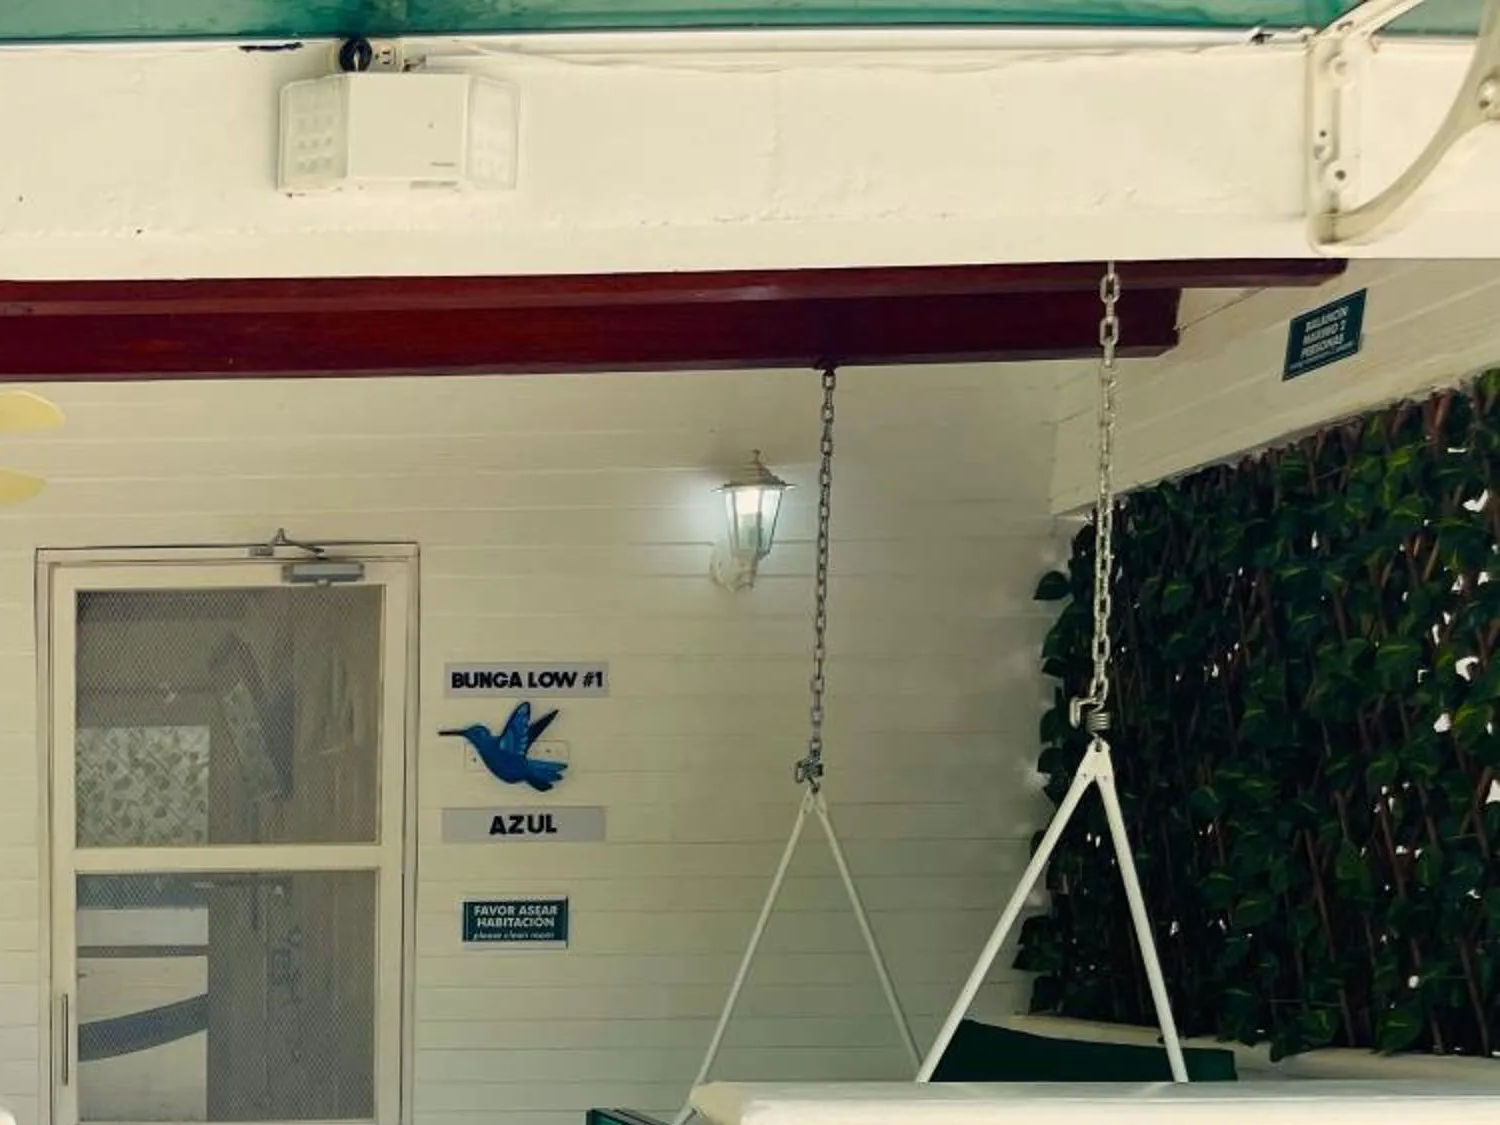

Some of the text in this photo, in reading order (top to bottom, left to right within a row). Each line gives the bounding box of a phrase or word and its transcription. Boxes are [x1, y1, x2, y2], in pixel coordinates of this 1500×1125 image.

[451, 671, 604, 689] BUNGA LOW #1
[489, 814, 558, 835] AZUL
[474, 905, 557, 916] FAVOR ASEAR
